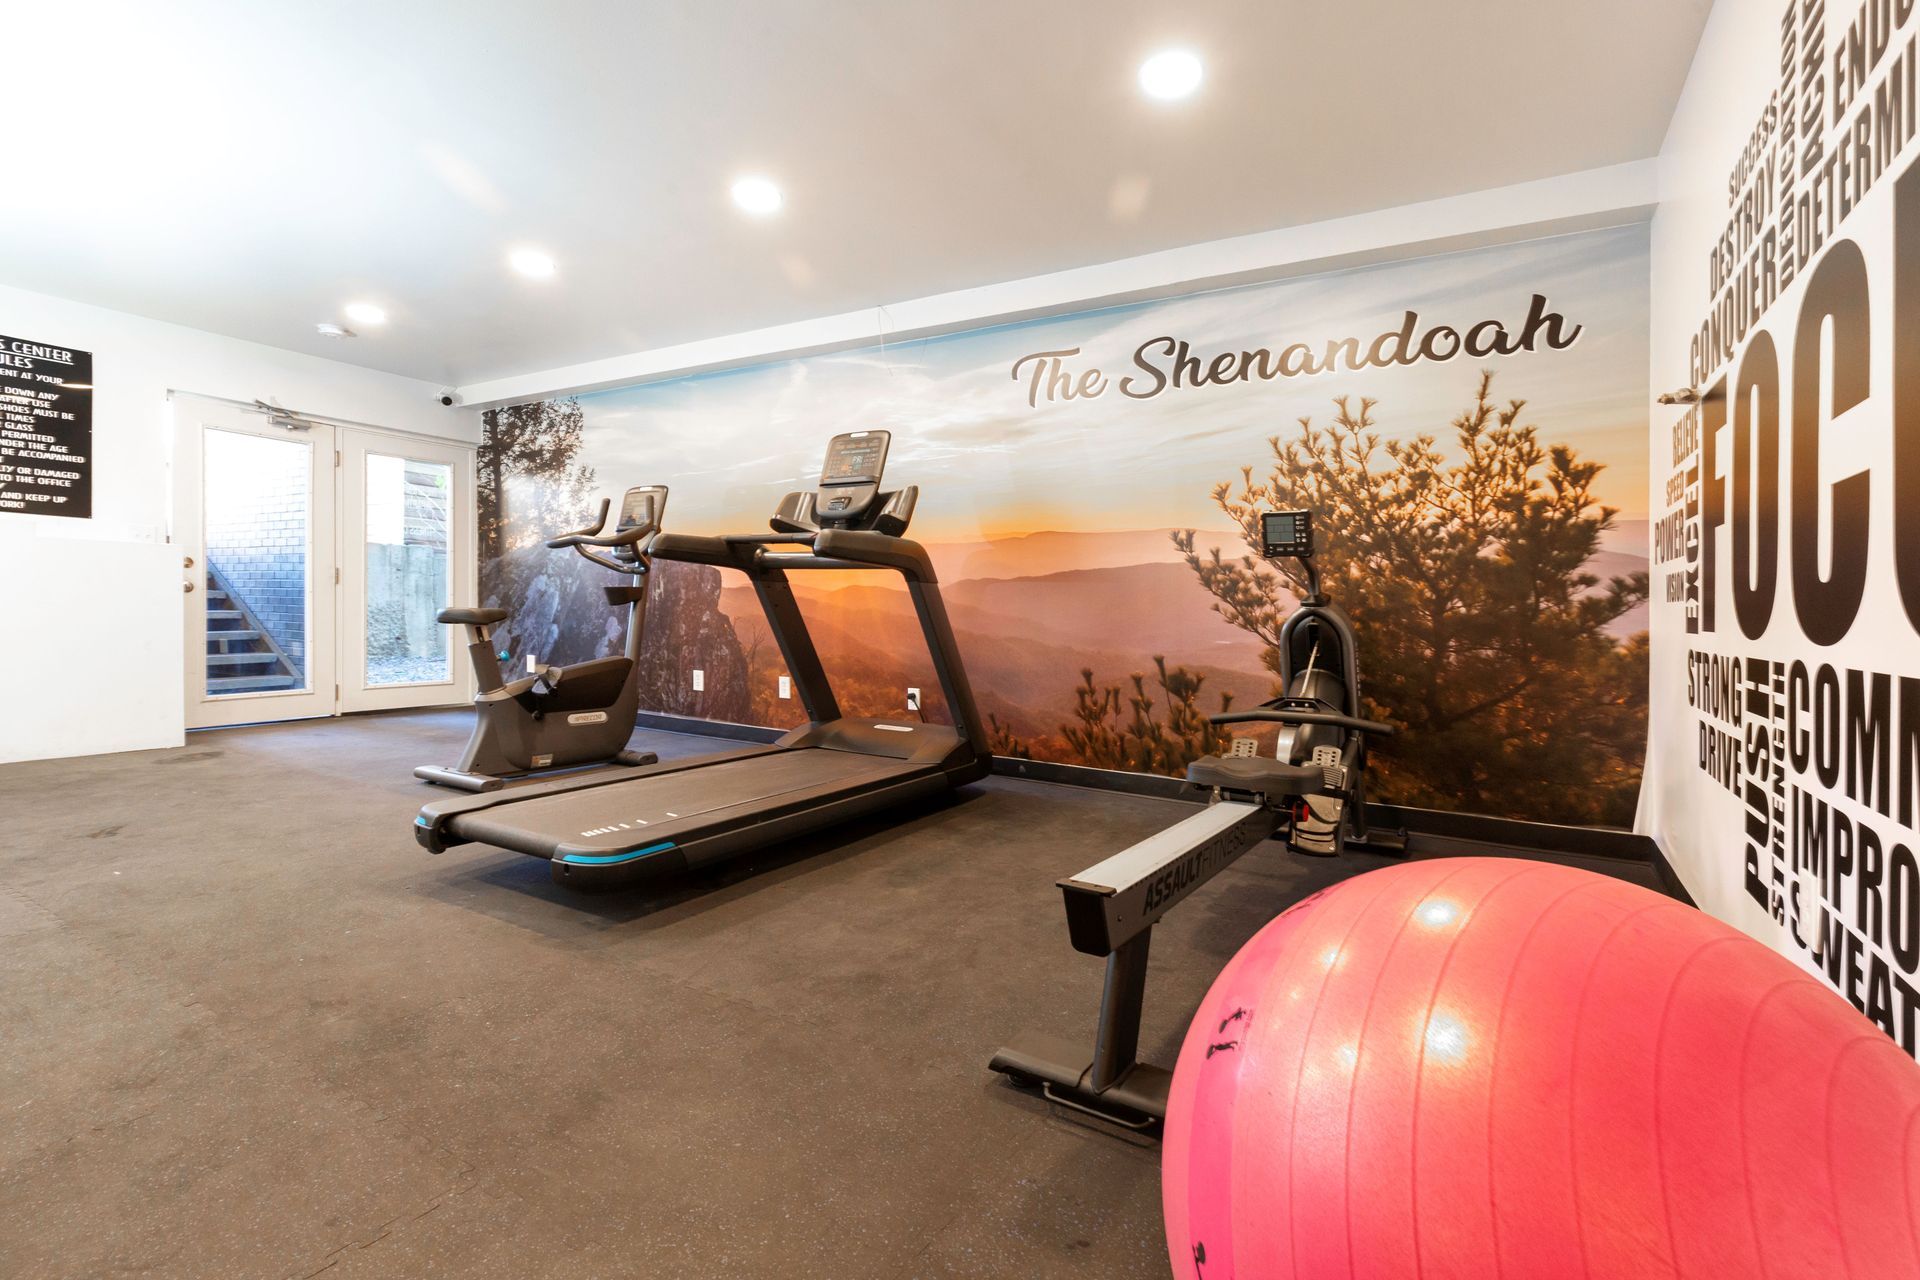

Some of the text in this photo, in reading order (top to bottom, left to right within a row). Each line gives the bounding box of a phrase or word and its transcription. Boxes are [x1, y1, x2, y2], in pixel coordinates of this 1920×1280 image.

[1728, 88, 1778, 209] SUCCESS
[1780, 0, 1796, 296] DEDICATION
[1709, 142, 1777, 304] DESTROY
[1690, 223, 1776, 389] CONQUER
[12, 341, 73, 362] CENTER
[1011, 293, 1583, 408] The Shenandoah
[4, 386, 36, 398] DOWN
[37, 392, 60, 401] ANY
[21, 371, 33, 380] AT
[35, 373, 64, 385] YOUR
[31, 400, 51, 409] USE
[32, 408, 60, 418] MUST
[61, 412, 76, 420] BE
[1700, 150, 1920, 647] FOC
[4, 421, 35, 432] GLASS
[5, 412, 36, 423] TIMES
[1, 430, 55, 443] PERMITTED
[27, 441, 48, 451] THE
[49, 445, 69, 454] AGE
[1672, 404, 1699, 468] BELIEVE
[1, 447, 16, 456] BE
[18, 449, 86, 464] ACCOMPANIED
[16, 466, 33, 475] OR
[33, 468, 81, 480] DAMAGED
[0, 491, 68, 504] AND KEEP UP
[15, 475, 36, 484] THE
[37, 477, 72, 488] OFFICE
[1666, 469, 1684, 508] SPEED
[1654, 508, 1685, 565] POWER
[1685, 453, 1700, 635] EXCEL
[1666, 571, 1685, 603] VISION
[1687, 648, 1742, 729] STRONG
[1698, 719, 1743, 800] DRIVE
[1744, 656, 1771, 915] PUSH
[1771, 661, 1787, 928] STRENGTH
